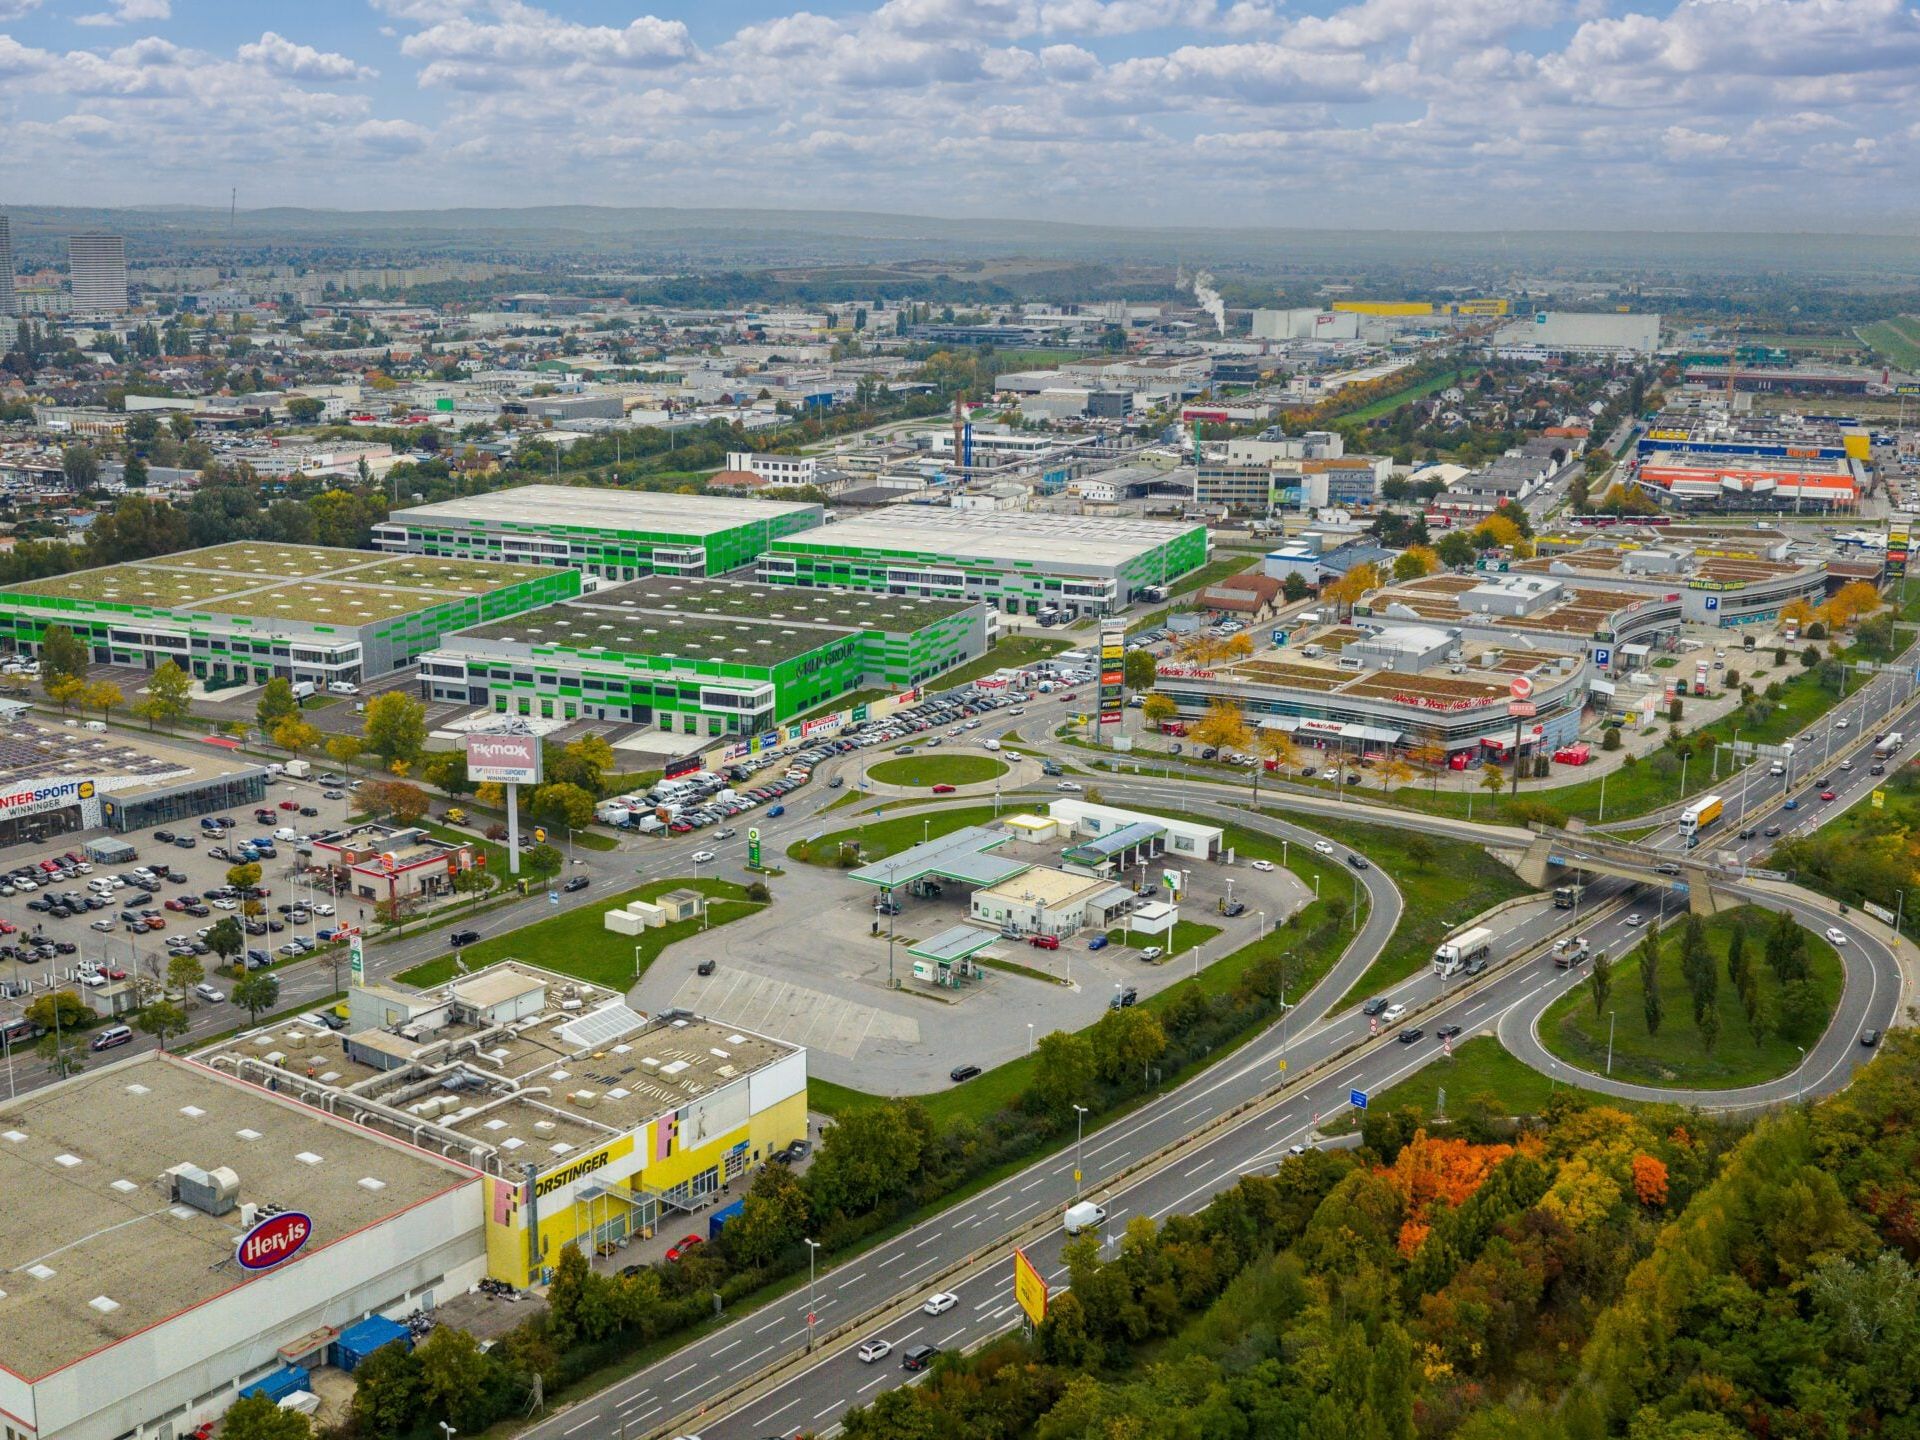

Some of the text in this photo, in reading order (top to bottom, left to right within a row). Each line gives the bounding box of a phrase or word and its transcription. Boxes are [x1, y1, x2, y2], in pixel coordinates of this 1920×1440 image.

[825, 642, 855, 665] GROUP
[1598, 651, 1607, 662] P
[483, 768, 527, 776] INTERSPORT
[0, 783, 77, 808] NTERSPORT
[8, 799, 61, 816] WINNINGER
[535, 1152, 609, 1198] ORSTINGER
[247, 1222, 306, 1261] Hervis
